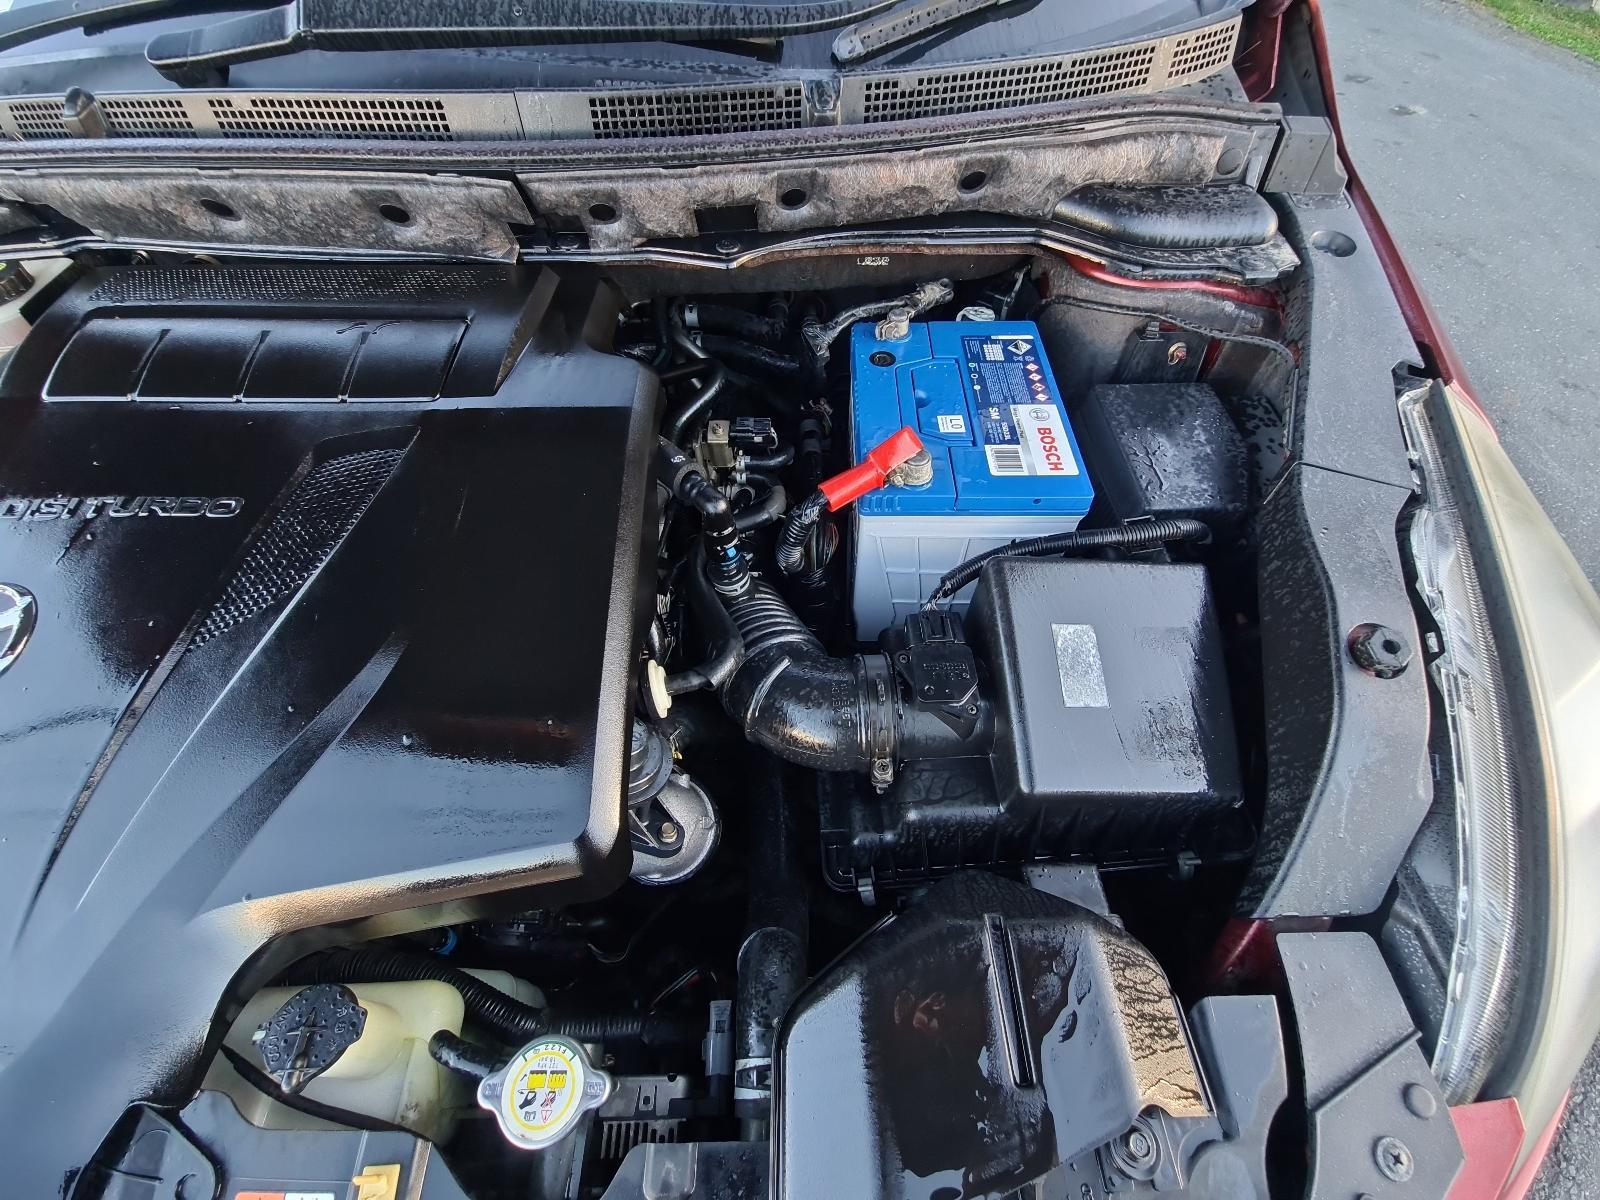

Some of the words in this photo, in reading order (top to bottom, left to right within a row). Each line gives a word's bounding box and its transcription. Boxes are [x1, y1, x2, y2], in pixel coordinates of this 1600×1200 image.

[988, 407, 1000, 419] SM
[1037, 427, 1064, 471] BOSCH
[0, 496, 80, 519] DISI
[86, 496, 245, 518] TURBO
